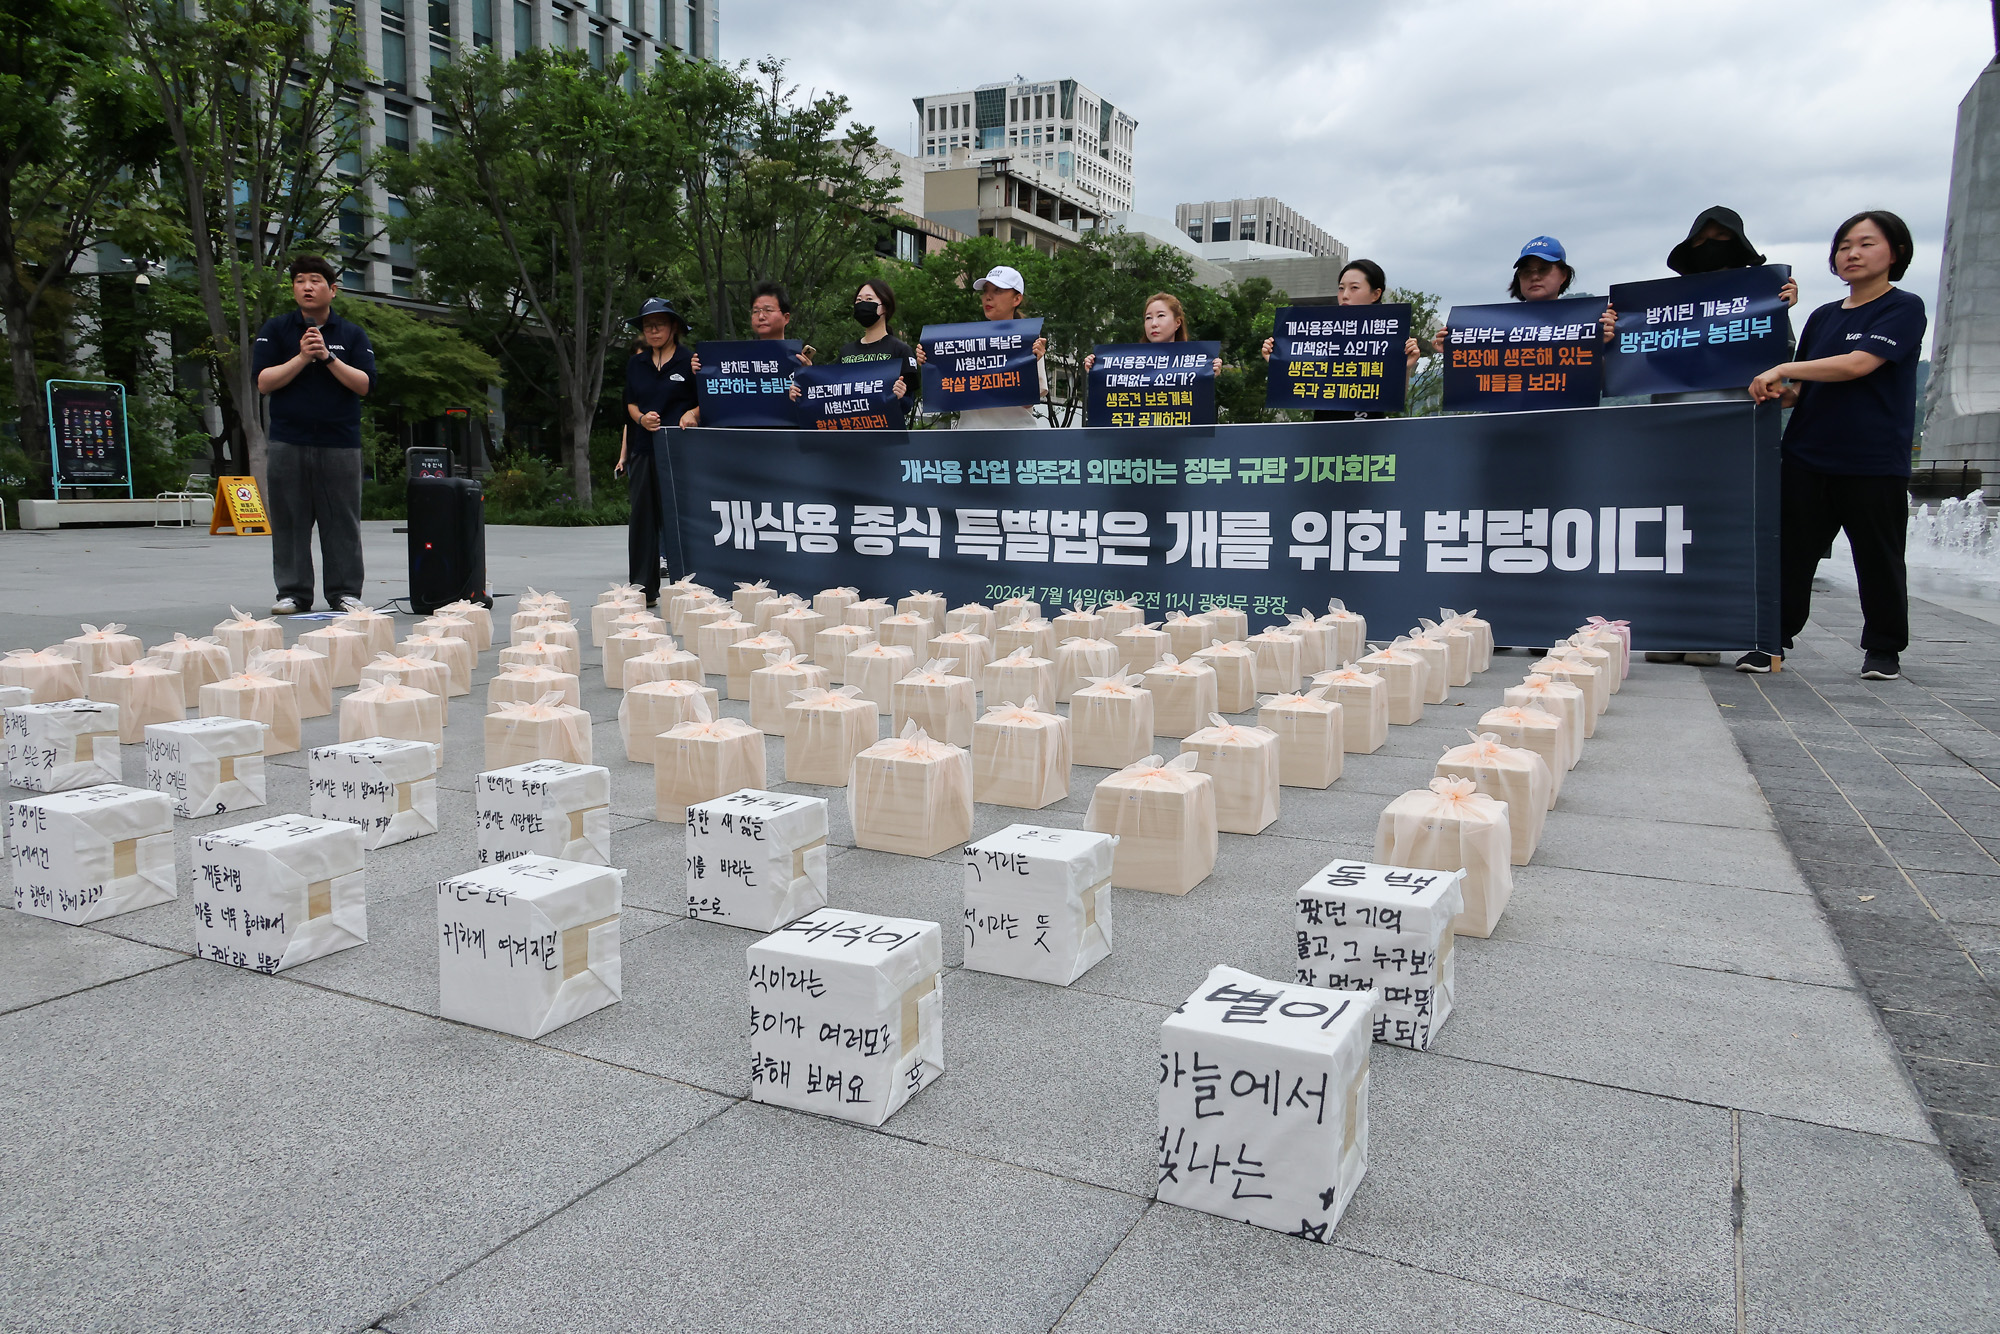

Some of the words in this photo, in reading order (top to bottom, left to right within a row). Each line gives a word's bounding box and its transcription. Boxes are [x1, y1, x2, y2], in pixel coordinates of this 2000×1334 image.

[1646, 303, 1694, 324] 방치된
[1700, 296, 1750, 318] 개농장
[1285, 320, 1358, 336] 개식용종식법
[1361, 319, 1399, 335] 시행은
[1450, 327, 1505, 344] 농림부는
[1508, 323, 1597, 343] 성과홍보말고
[1620, 328, 1701, 354] 방관하는
[1707, 315, 1773, 345] 농림부
[934, 337, 987, 355] 생존견에게
[989, 335, 1022, 350] 복날은
[1290, 341, 1340, 357] 대책없는
[1344, 340, 1389, 356] 쇼인가?
[720, 360, 750, 374] 방치된
[751, 360, 779, 373] 개농장
[955, 354, 1008, 372] 사형선고다
[1102, 355, 1169, 370] 개식용종식법
[1172, 354, 1207, 368] 시행은
[1452, 349, 1499, 367] 현장에
[1504, 347, 1553, 367] 생존해
[1558, 347, 1593, 366] 있는
[1106, 374, 1151, 388] 대책없는
[1153, 372, 1196, 387] 쇼인가?
[1288, 361, 1328, 378] 생존견
[1331, 361, 1384, 378] 보호계획
[706, 378, 757, 394] 방관하는
[807, 383, 852, 399] 생존견에게
[854, 379, 884, 393] 복날은
[941, 376, 966, 393] 학살
[969, 372, 1021, 391] 방조마라!
[1292, 383, 1320, 399] 즉각
[1322, 383, 1380, 399] 공개하라!
[1475, 374, 1523, 392] 개들을
[1527, 373, 1567, 392] 보라!
[824, 399, 870, 415] 사형선고다
[1106, 392, 1142, 408] 생존견
[1145, 391, 1193, 407] 보호계획
[840, 414, 889, 430] 방조마라!
[1111, 412, 1136, 427] 즉각
[1138, 411, 1191, 426] 공개하라!
[900, 459, 962, 485] 개식용
[967, 459, 1011, 485] 산업
[1016, 458, 1081, 485] 생존견
[1087, 457, 1177, 485] 외면하는
[1184, 456, 1231, 485] 정부
[1237, 456, 1288, 485] 규탄
[1294, 454, 1396, 483] 기자회견
[711, 501, 840, 554] 개식용
[851, 505, 941, 559] 종식
[954, 508, 1149, 567] 특별법은
[1165, 510, 1274, 570] 개를
[1288, 509, 1407, 572] 위한
[1423, 505, 1693, 574] 법령이다
[1040, 587, 1063, 605] 7월
[1131, 591, 1161, 610] 오전
[1165, 592, 1194, 612] 11시
[1252, 595, 1289, 616] 광장
[42, 748, 57, 770] 것
[721, 812, 734, 834] 새
[739, 816, 766, 841] 삶을
[720, 858, 758, 888] 바라는
[1356, 906, 1402, 935] 기억
[782, 920, 921, 952] 대식이
[1033, 914, 1053, 954] 뜻
[443, 921, 487, 960] 귀하게
[498, 930, 558, 971] 여겨지길
[1343, 940, 1361, 963] 그
[749, 964, 827, 998] 식이라는
[1204, 983, 1352, 1030] 별이
[806, 1063, 872, 1104] 보여요
